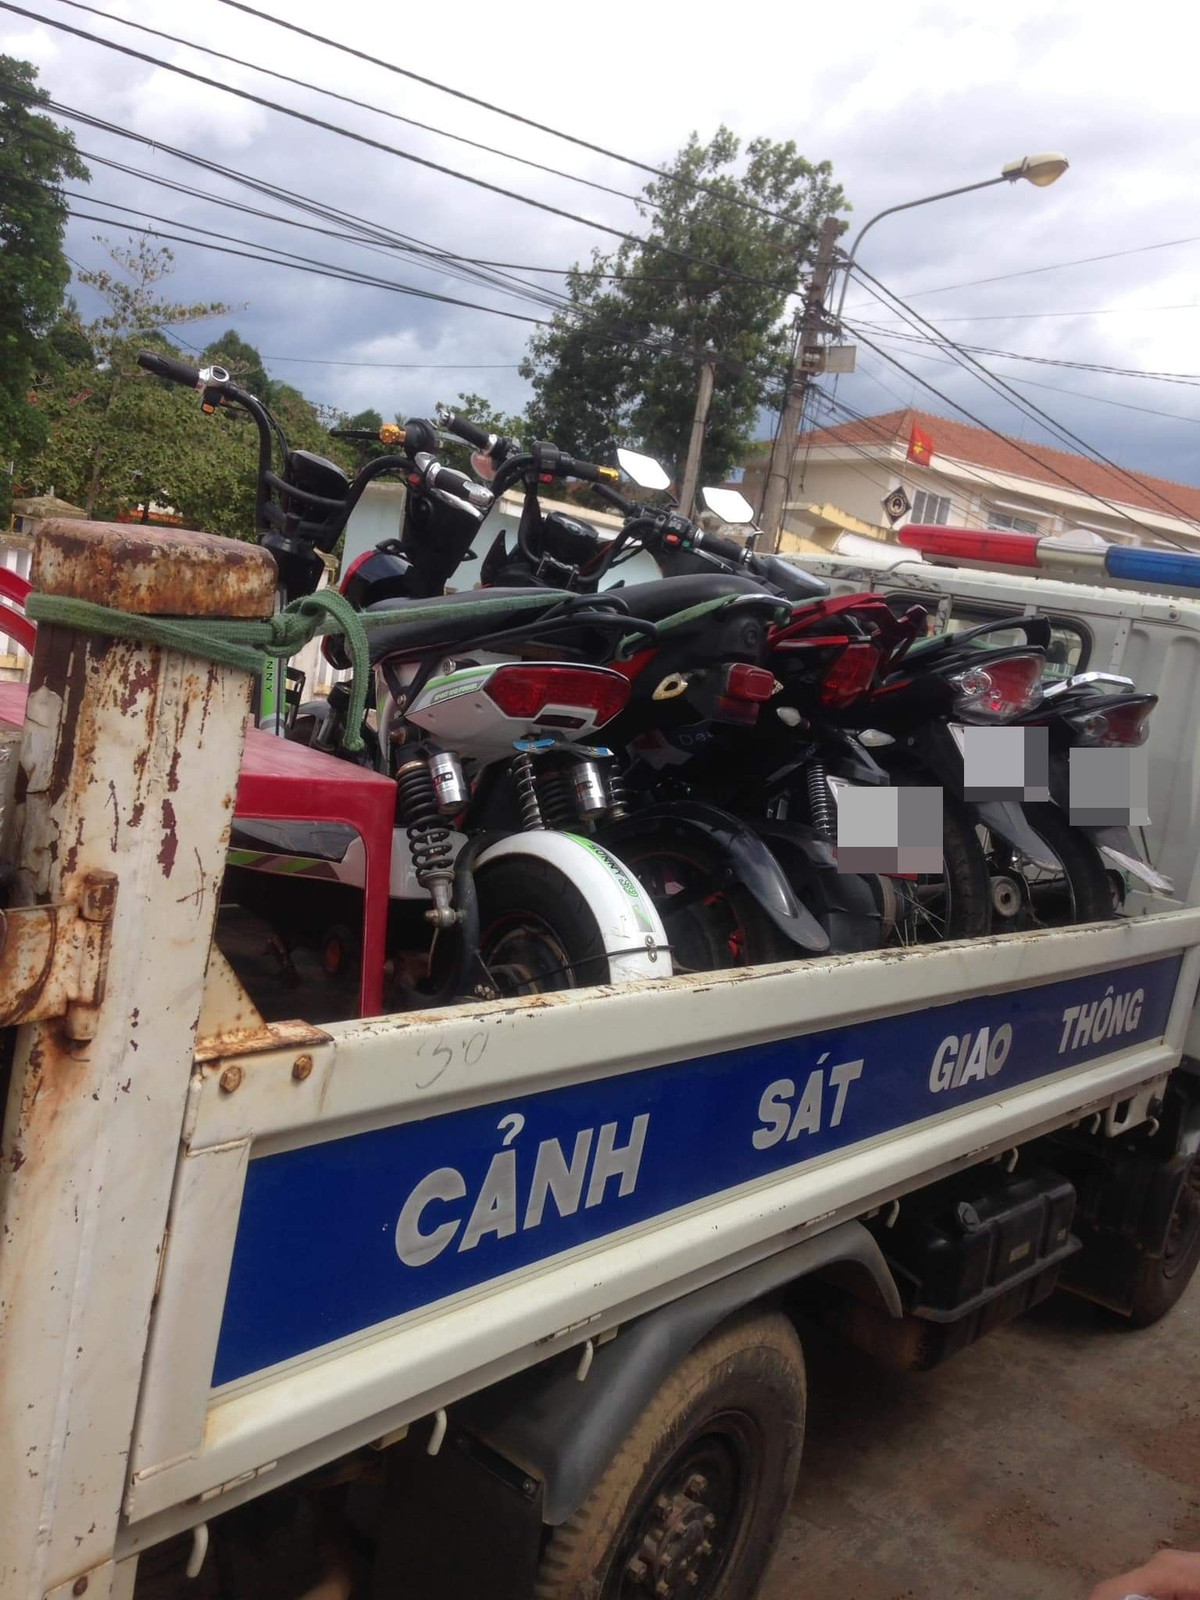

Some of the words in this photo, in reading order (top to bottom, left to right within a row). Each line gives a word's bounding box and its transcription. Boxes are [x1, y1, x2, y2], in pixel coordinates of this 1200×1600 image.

[395, 1113, 650, 1267] CẢNH
[752, 1052, 864, 1150] SÁT
[929, 1022, 1013, 1094] GIAO
[1058, 985, 1144, 1053] THÔNG
